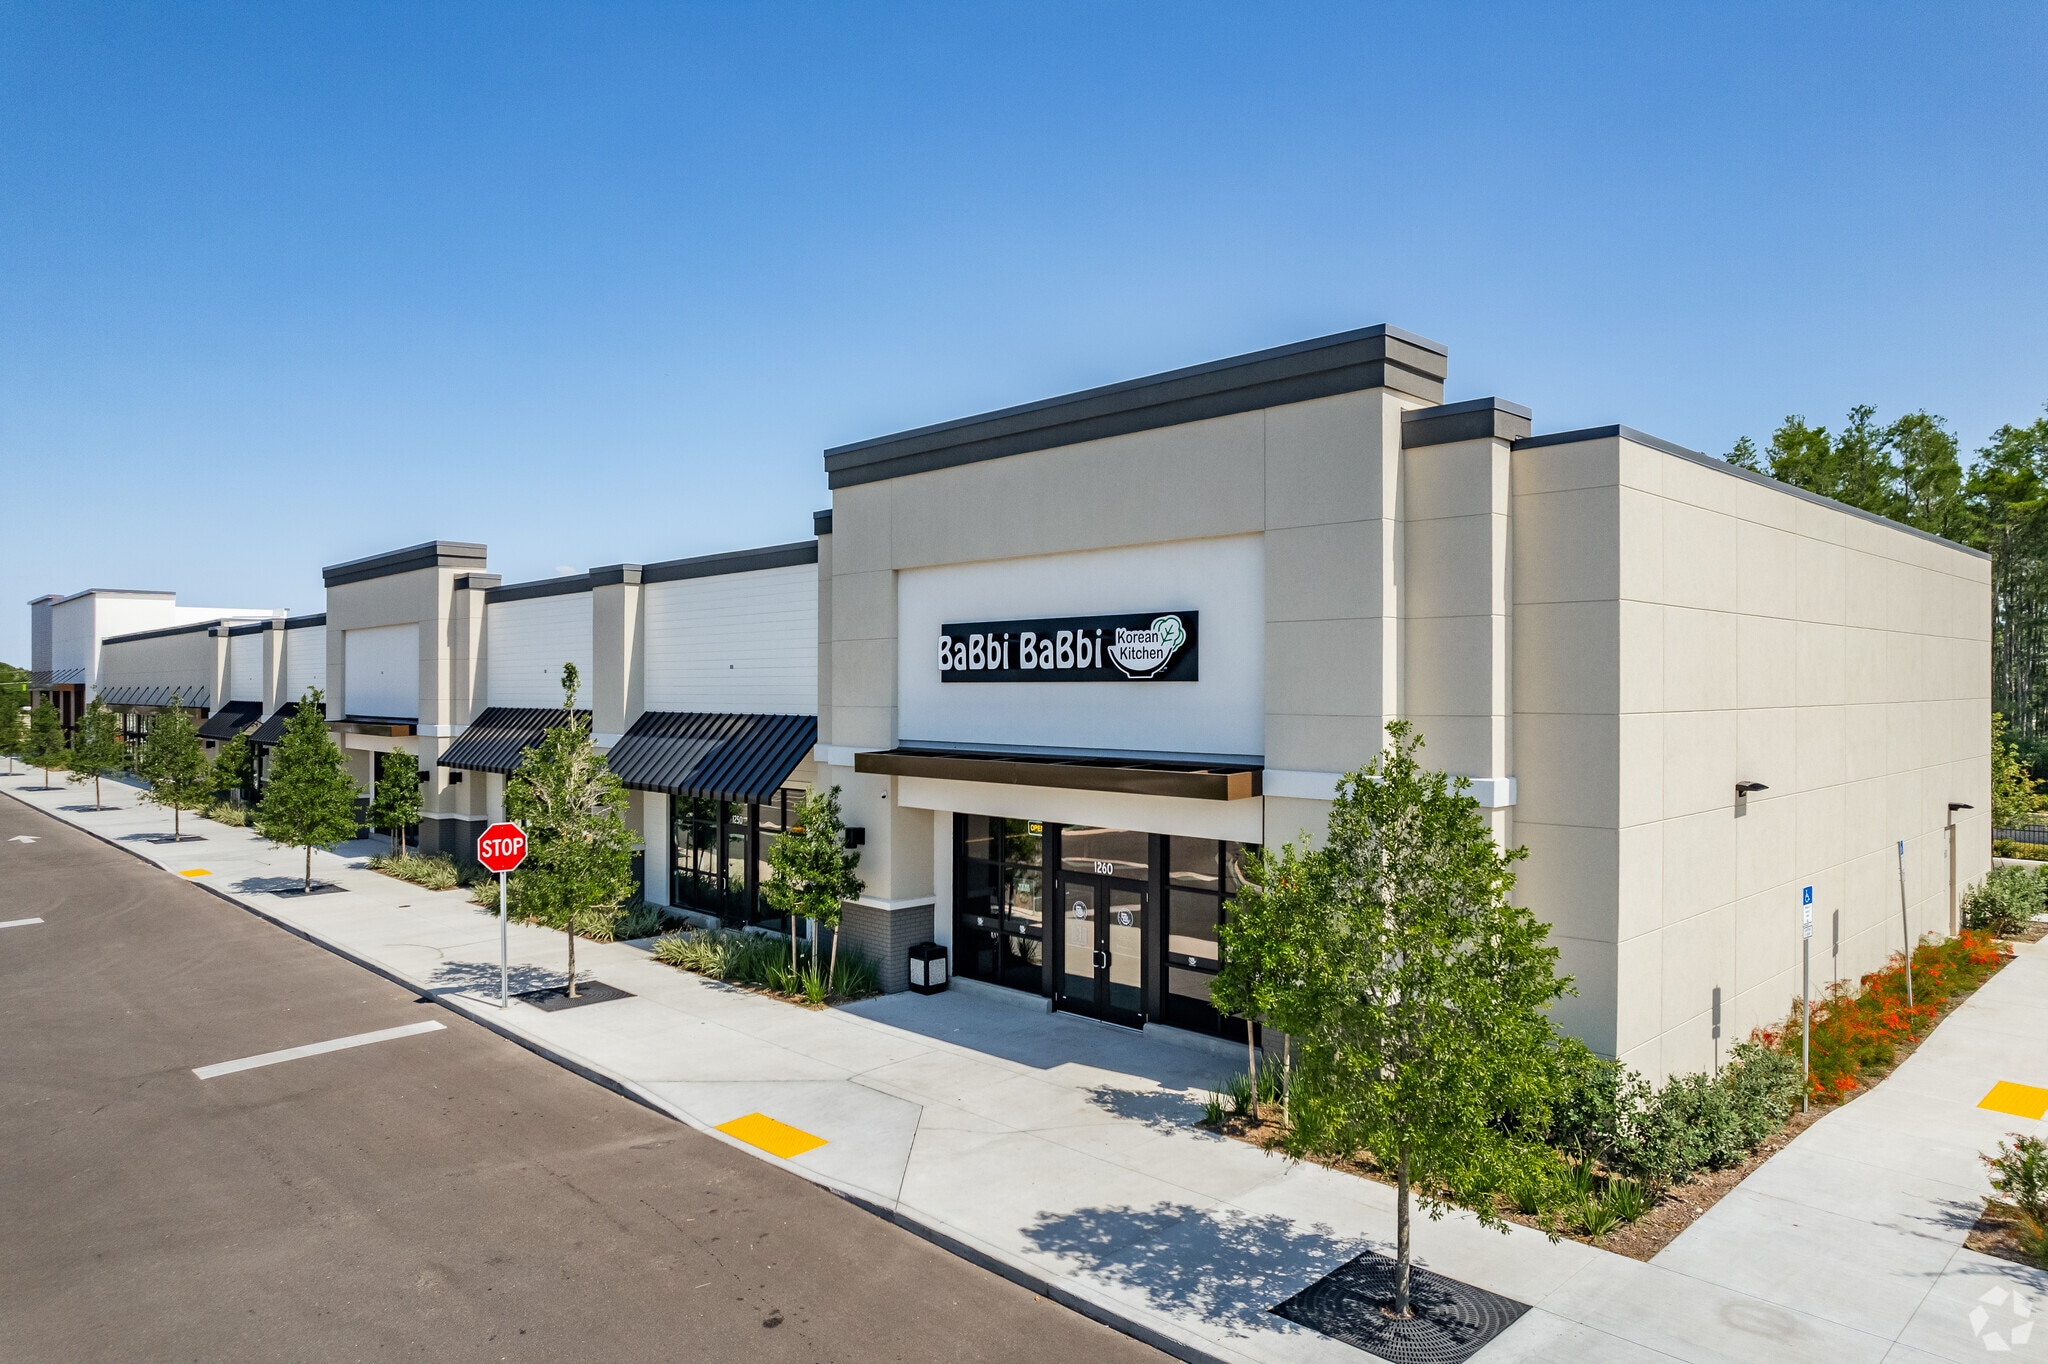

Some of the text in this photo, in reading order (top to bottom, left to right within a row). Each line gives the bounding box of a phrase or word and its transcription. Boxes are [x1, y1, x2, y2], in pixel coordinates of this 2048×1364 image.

[1117, 630, 1159, 644] Korean
[938, 629, 1103, 671] BaBbi BaBbi
[1120, 646, 1164, 660] Kitchen
[482, 838, 524, 858] STOP
[1094, 861, 1113, 875] 1260
